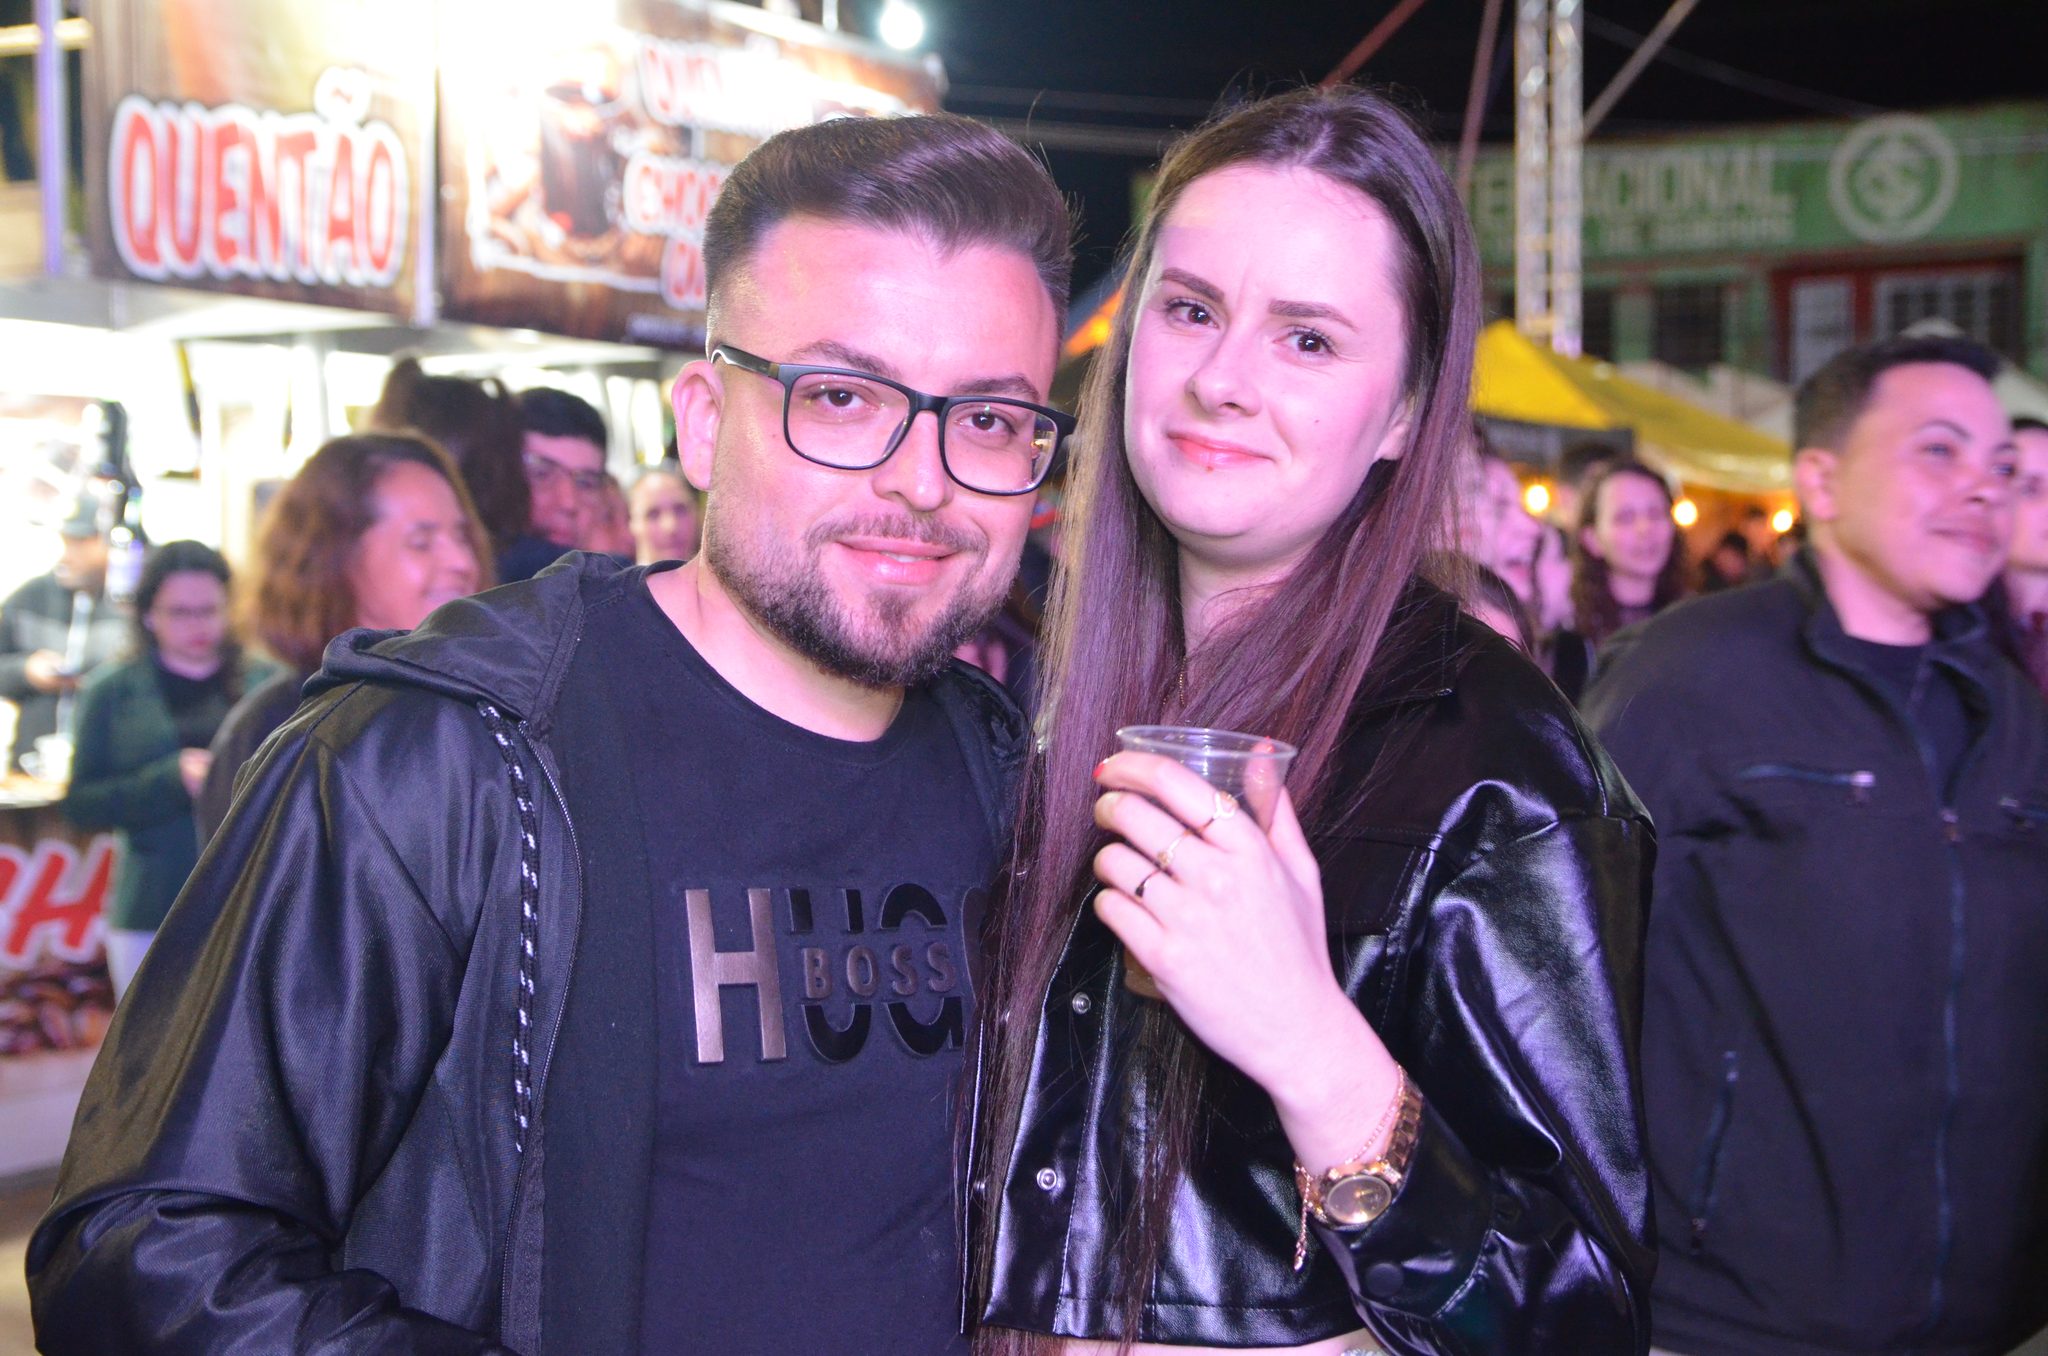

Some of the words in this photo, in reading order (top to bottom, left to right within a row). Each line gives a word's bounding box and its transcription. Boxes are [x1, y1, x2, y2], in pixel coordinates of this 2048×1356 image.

[114, 70, 404, 283] QUENTÃO
[685, 882, 985, 1064] HUG
[803, 943, 956, 999] BOSS
